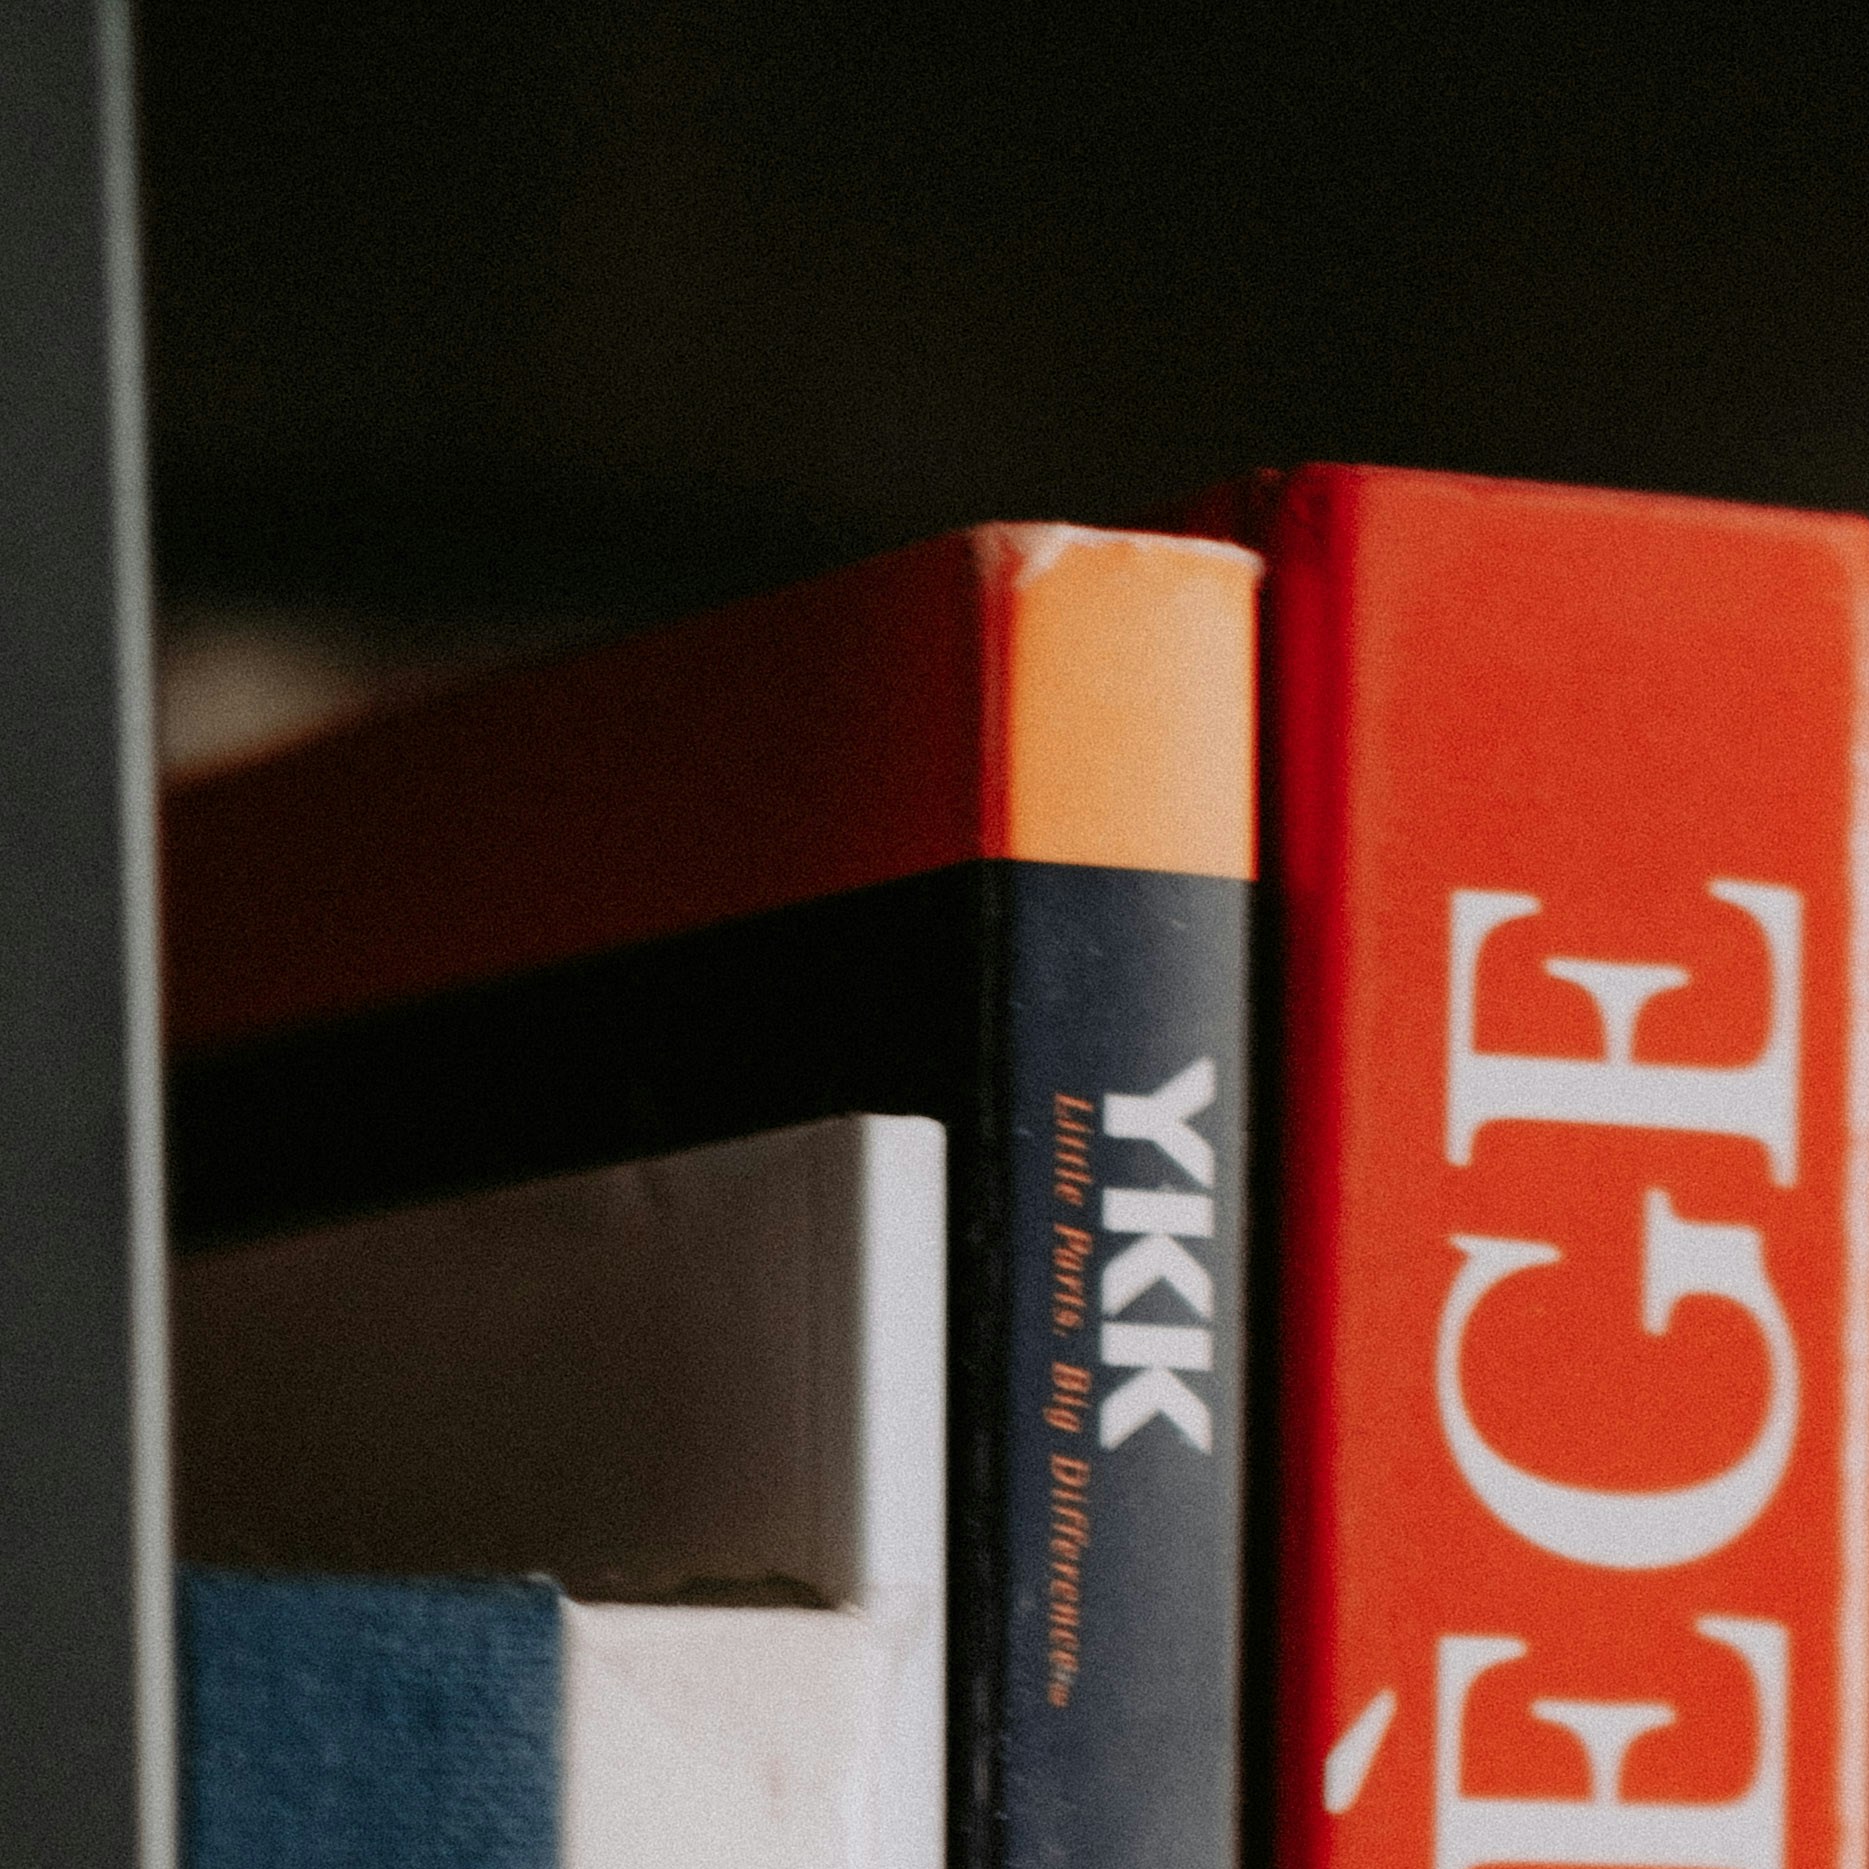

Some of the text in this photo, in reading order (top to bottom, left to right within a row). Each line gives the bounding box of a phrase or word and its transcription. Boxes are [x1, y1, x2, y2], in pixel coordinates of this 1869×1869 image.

[1052, 1092, 1094, 1207] Little
[1102, 1056, 1215, 1454] YKK
[1044, 1360, 1092, 1434] Big
